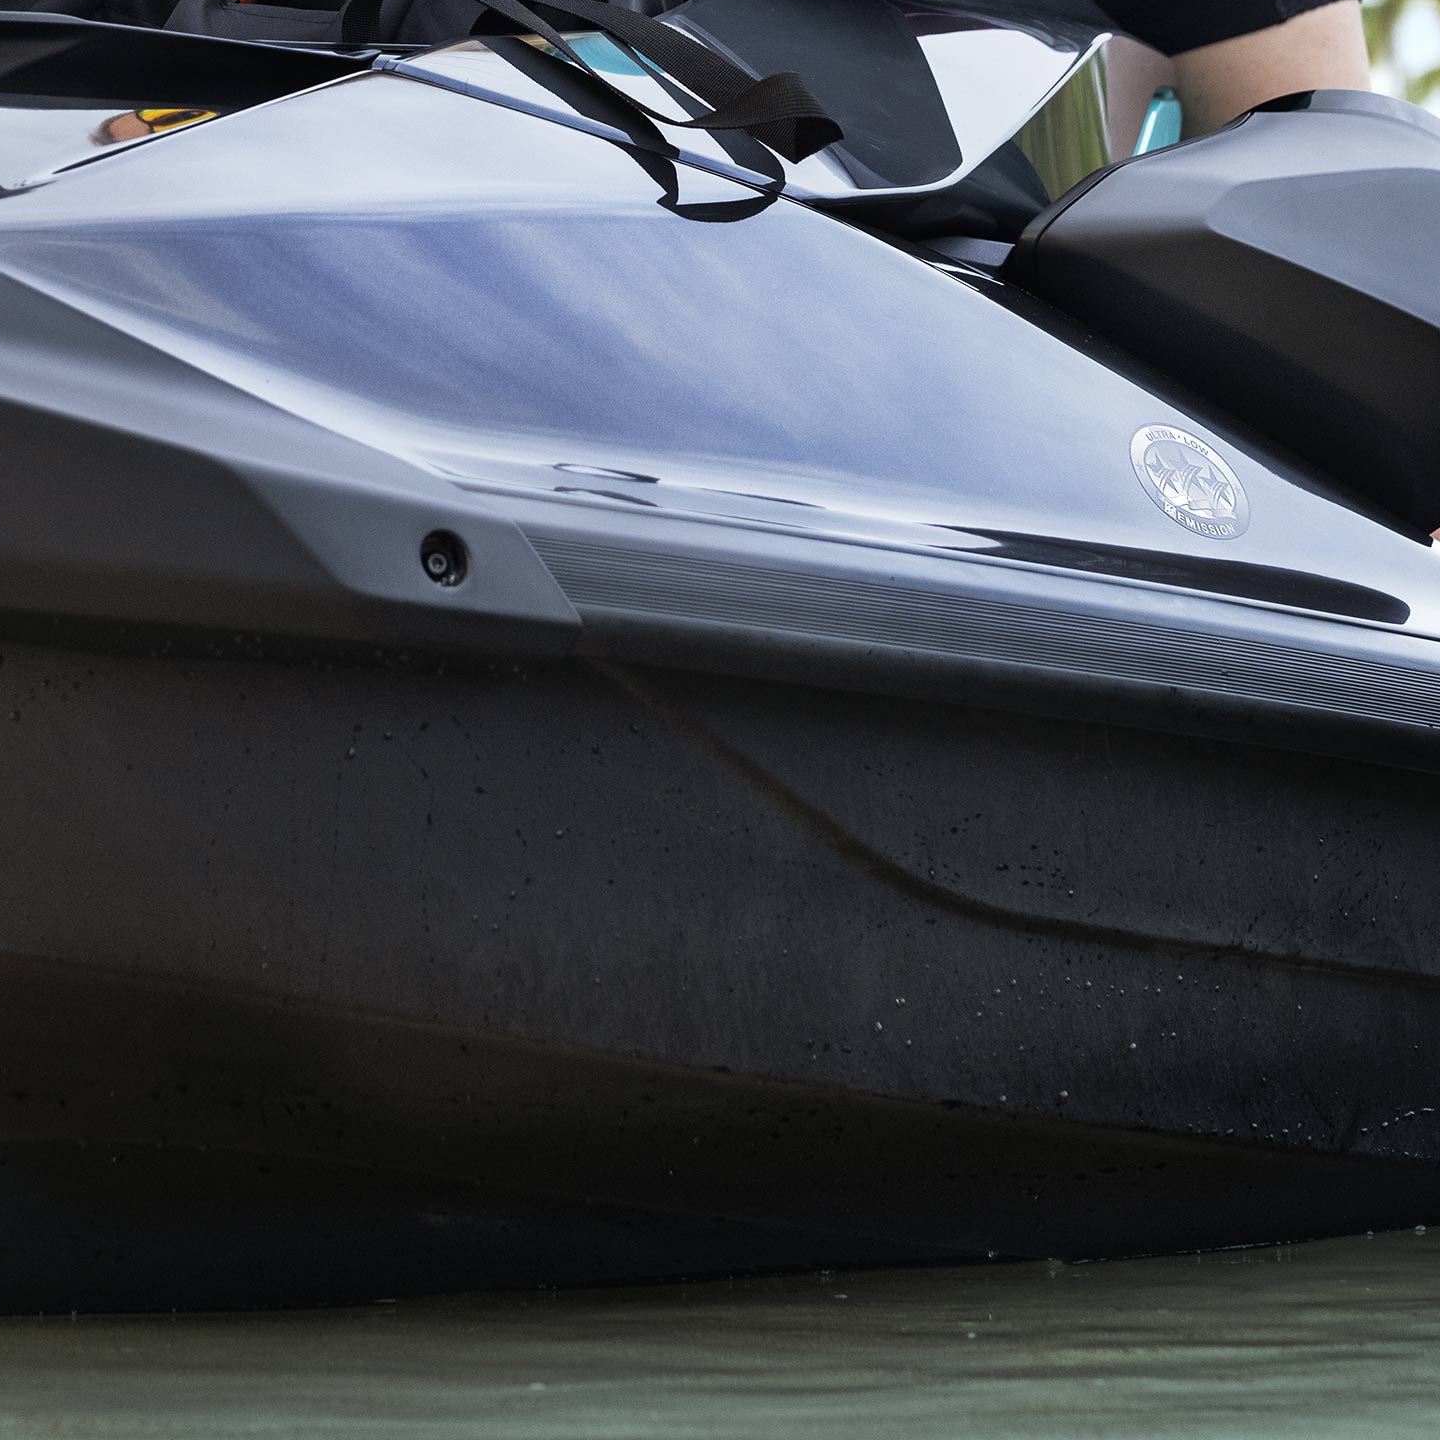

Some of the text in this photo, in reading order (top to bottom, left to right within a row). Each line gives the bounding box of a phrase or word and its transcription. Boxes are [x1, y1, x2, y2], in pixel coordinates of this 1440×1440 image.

[1146, 430, 1209, 456] ULTRA LOW
[1177, 511, 1236, 536] EMISSION
